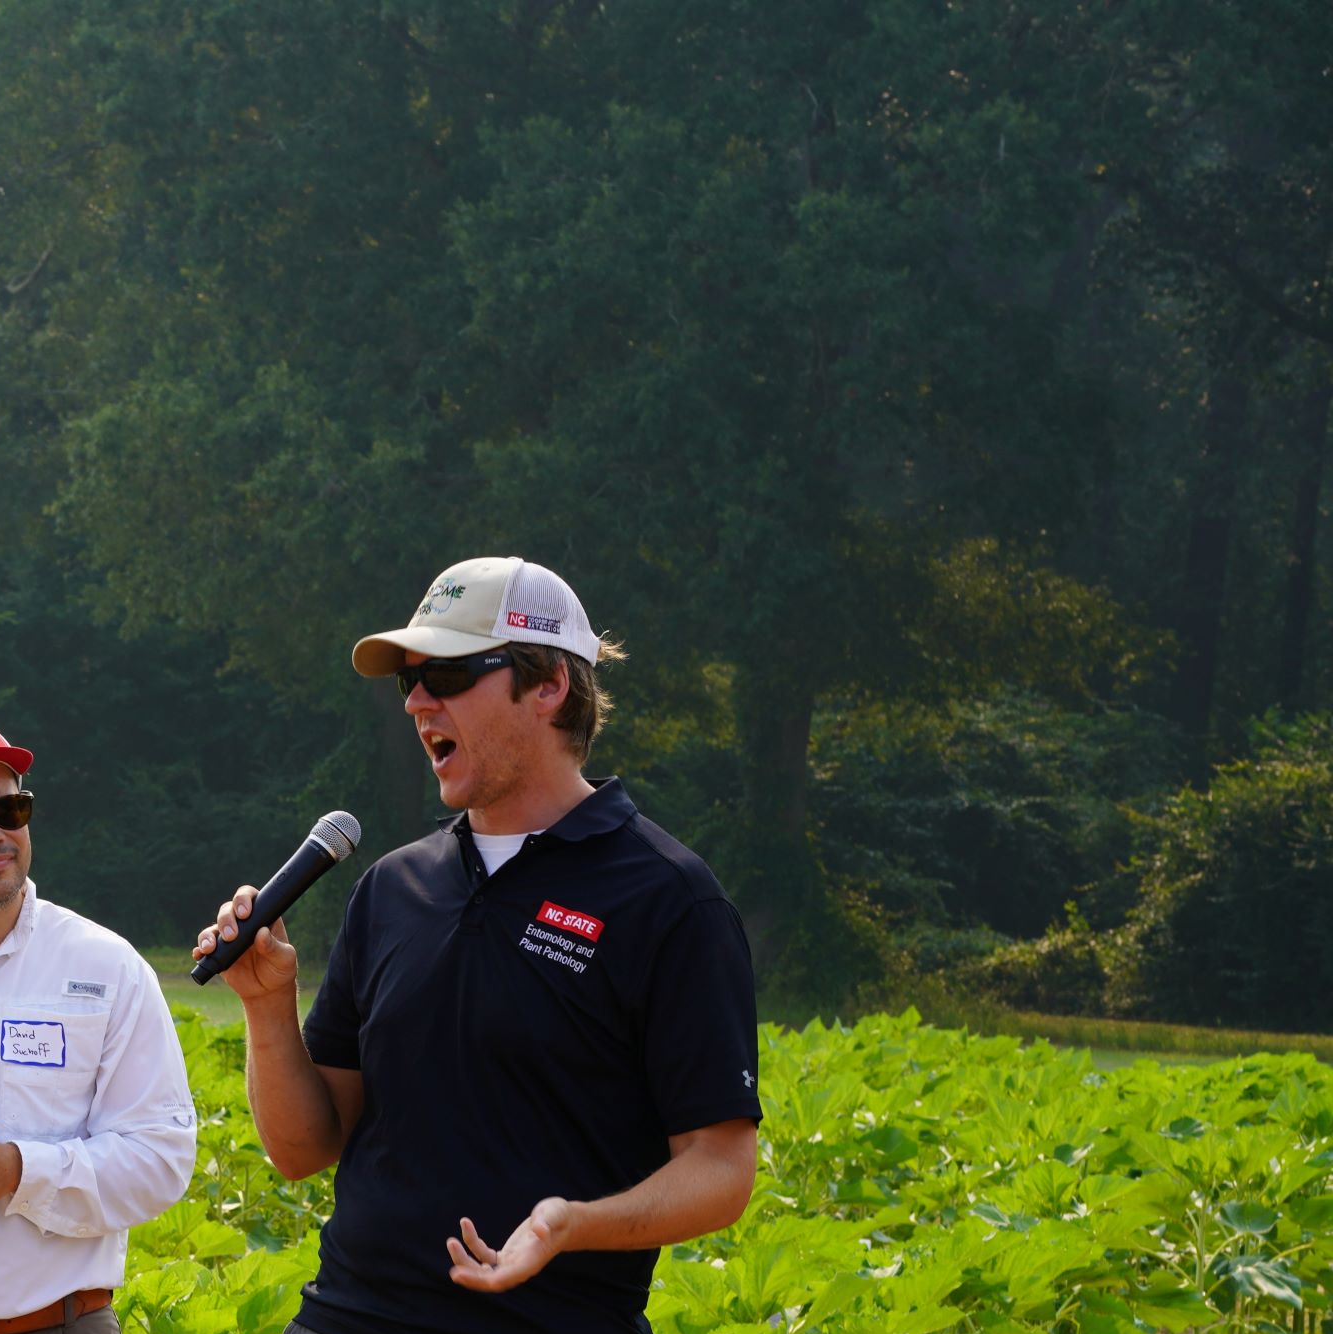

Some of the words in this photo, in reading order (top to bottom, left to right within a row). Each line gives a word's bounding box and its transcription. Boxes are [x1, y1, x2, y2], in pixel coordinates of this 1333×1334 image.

[509, 613, 525, 626] NC
[527, 623, 560, 633] EXTENSION
[484, 656, 502, 665] SMITH
[545, 907, 564, 922] NC
[562, 914, 597, 935] STATE
[525, 923, 577, 952] Entomology
[575, 944, 596, 958] and
[519, 937, 543, 955] Plant
[542, 945, 587, 974] Pathology
